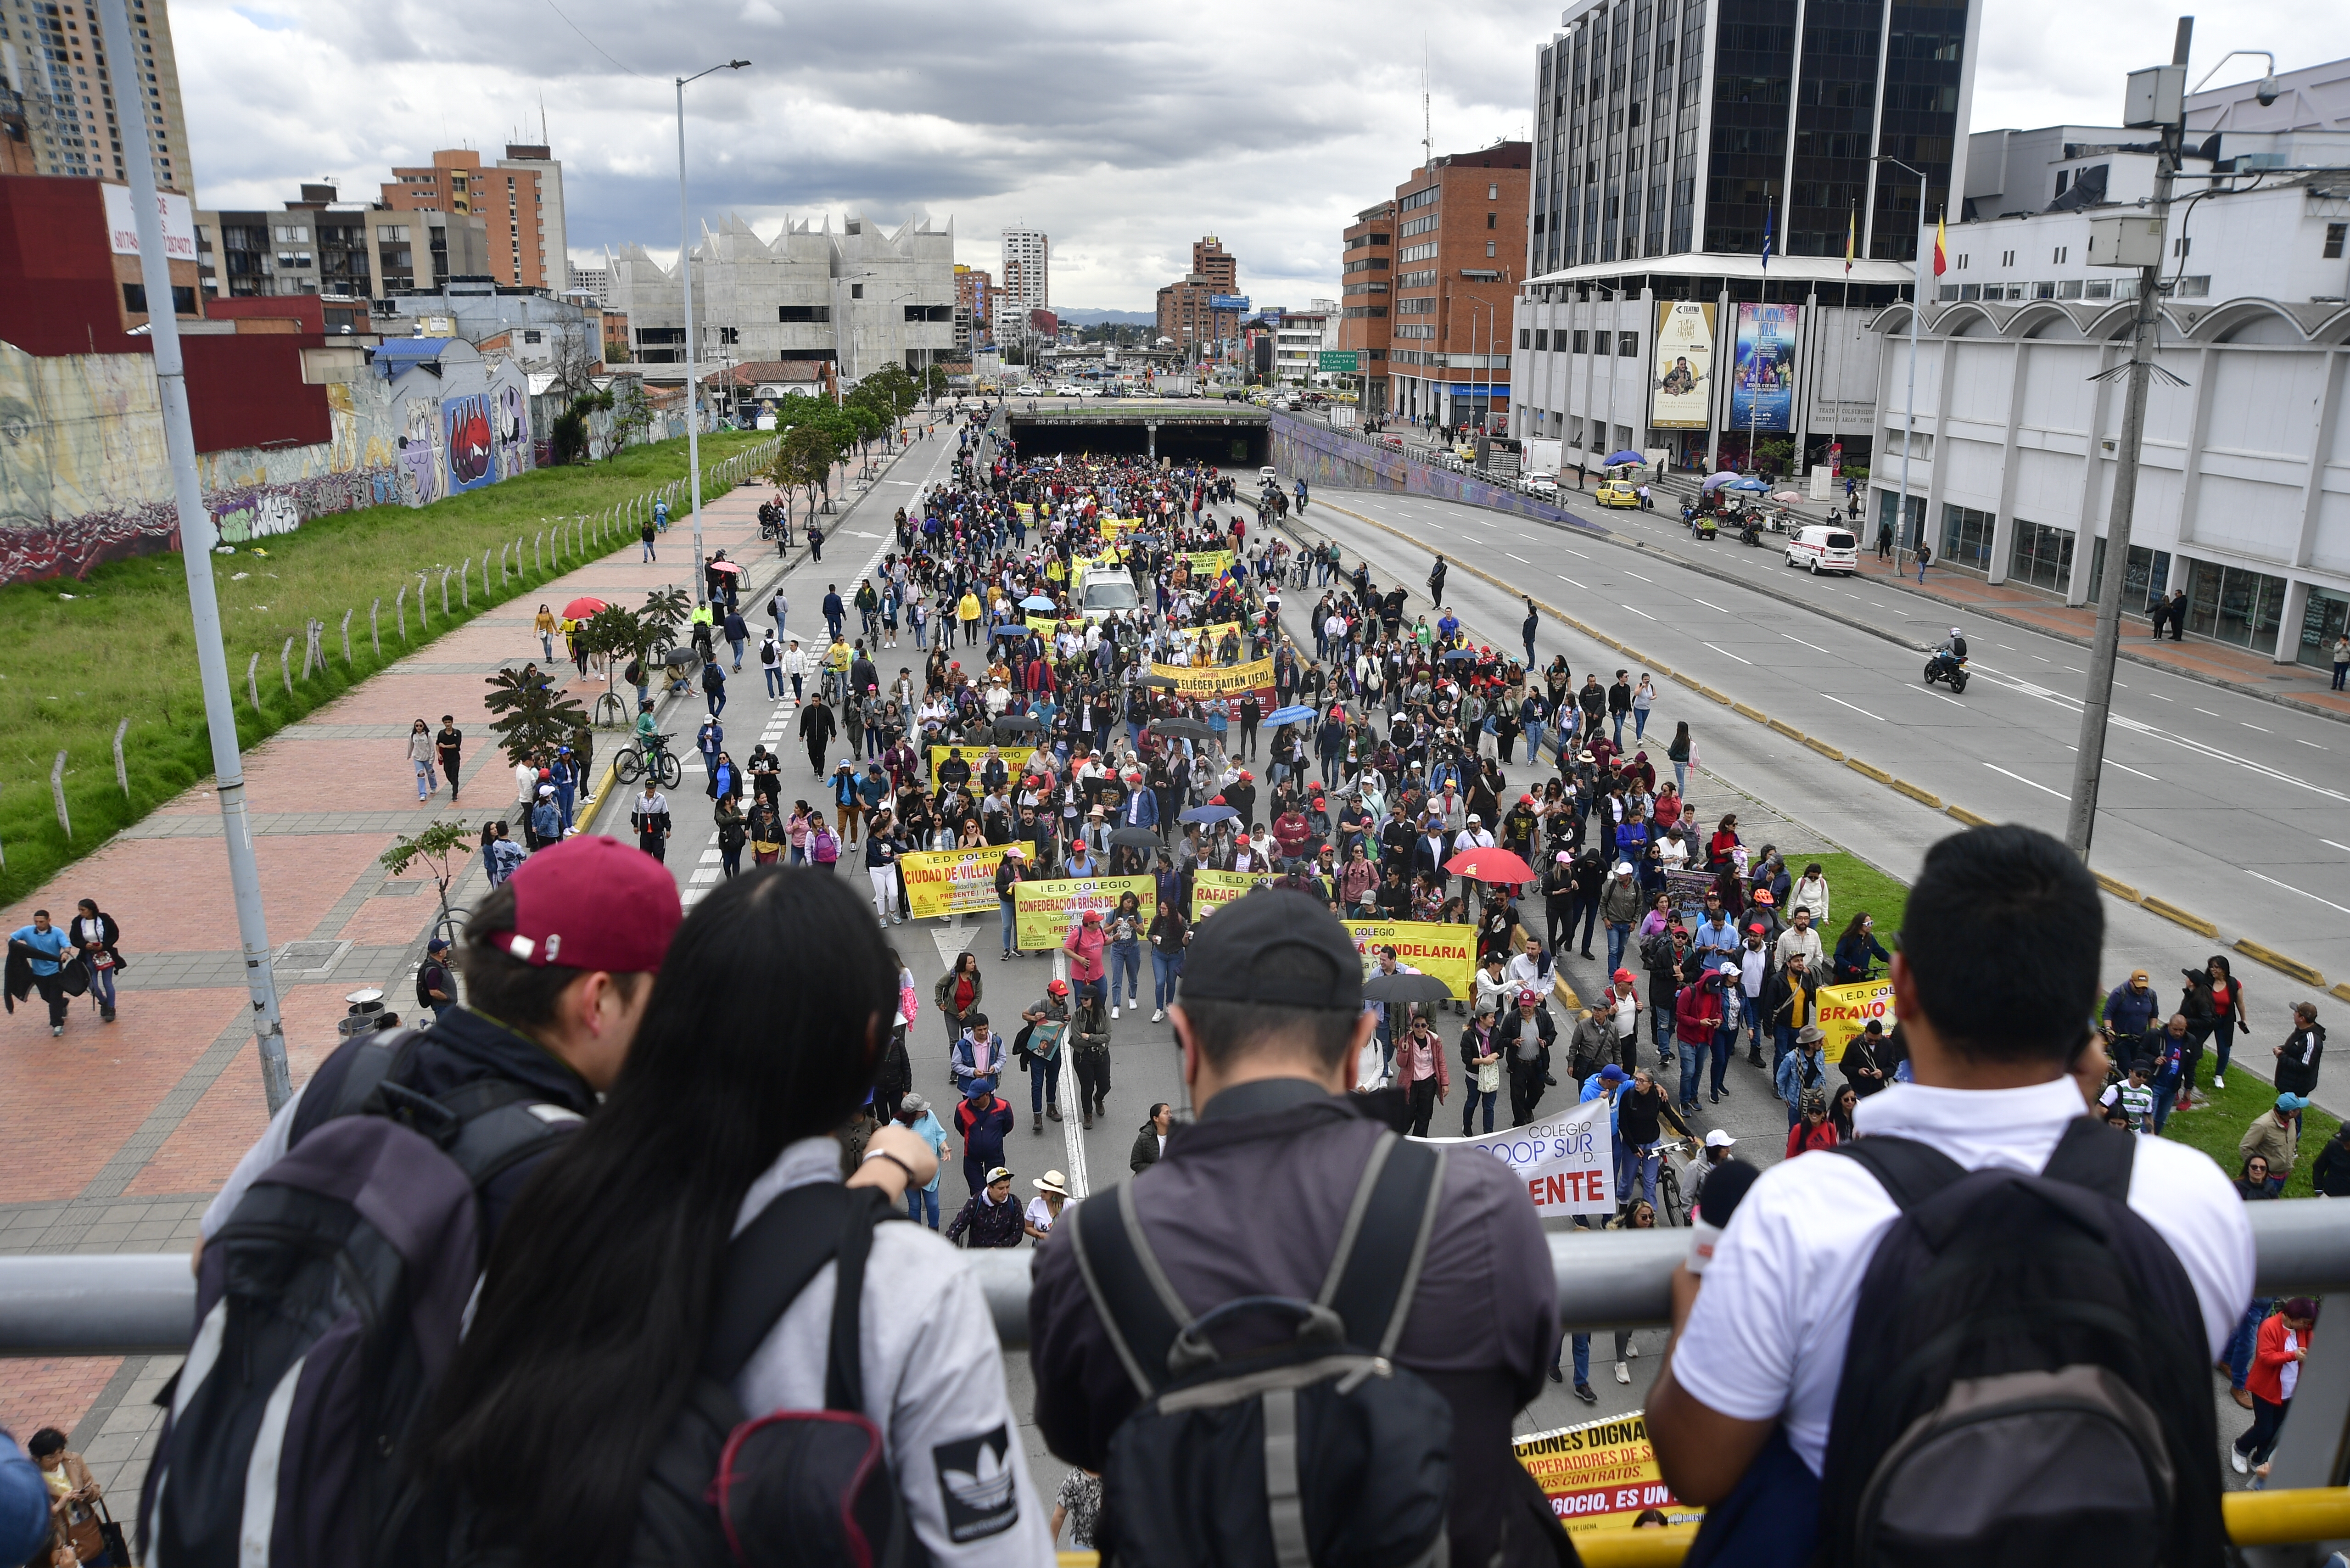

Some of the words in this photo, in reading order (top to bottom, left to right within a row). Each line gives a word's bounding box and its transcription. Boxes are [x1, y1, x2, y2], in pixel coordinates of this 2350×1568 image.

[1751, 307, 1785, 322] MAMMA
[1182, 678, 1214, 690] ELIÉCER
[1216, 675, 1246, 689] GAITÁN
[1248, 671, 1269, 685] (IED)
[1230, 697, 1266, 706] PRETE!
[755, 760, 770, 771] 24
[926, 856, 954, 864] I.E.D.
[905, 869, 941, 885] CIUDAD
[945, 867, 957, 881] DE
[1219, 875, 1247, 884] I.E.D.
[946, 883, 969, 891] Localidad
[1041, 884, 1070, 892] I.E.D.
[1074, 880, 1131, 890] COLEGIO
[1019, 898, 1076, 913] CONFEDERACION
[1079, 896, 1102, 909] BRISAS
[1104, 895, 1118, 908] DEL
[1050, 913, 1074, 922] Localidad
[1355, 927, 1395, 936] COLEGIO
[1841, 990, 1867, 1002] I.E.D.
[1819, 1002, 1886, 1022] BRAVO
[1035, 1026, 1054, 1039] PALESTINA
[1529, 1121, 1592, 1139] COLEGIO
[1555, 1133, 1593, 1158] SUR
[1584, 1152, 1596, 1163] D.
[1588, 1421, 1649, 1448] DIGNA
[1527, 1450, 1617, 1476] OPERADORES
[1621, 1447, 1639, 1462] DE
[1562, 1465, 1643, 1486] CONTRATOS.
[1616, 1489, 1639, 1508] ES
[1643, 1485, 1669, 1505] UN
